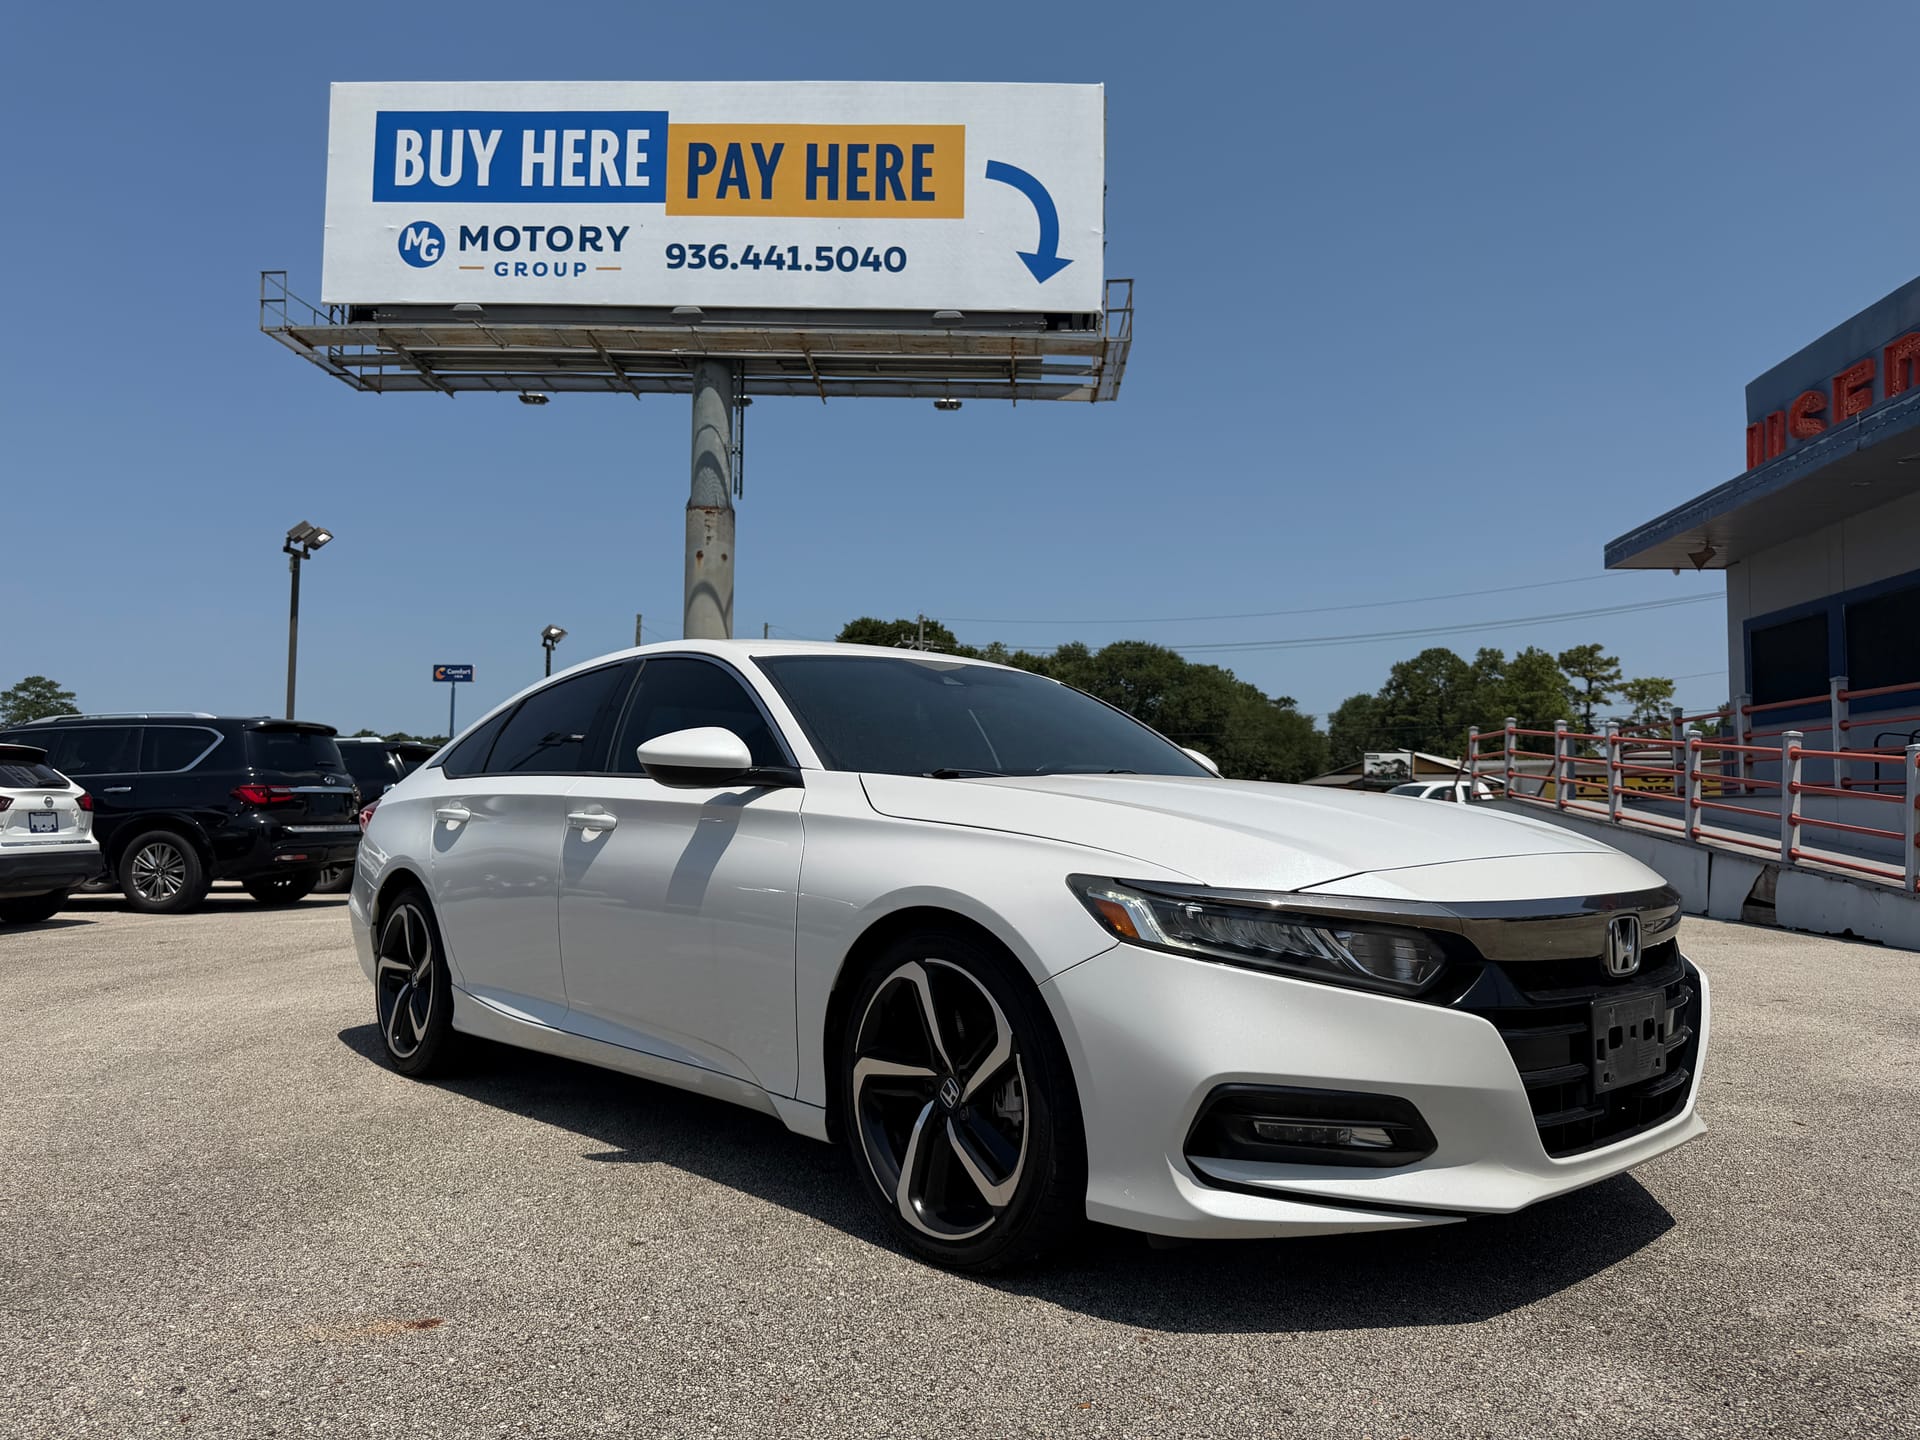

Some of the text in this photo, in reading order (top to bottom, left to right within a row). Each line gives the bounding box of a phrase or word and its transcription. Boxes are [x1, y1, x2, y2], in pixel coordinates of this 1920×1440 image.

[394, 128, 650, 187] BUY HERE
[686, 141, 936, 202] PAY HERE
[404, 226, 440, 262] MG
[459, 225, 630, 252] MOTORY
[494, 261, 587, 277] GROUP
[665, 242, 907, 273] 936.441.5040
